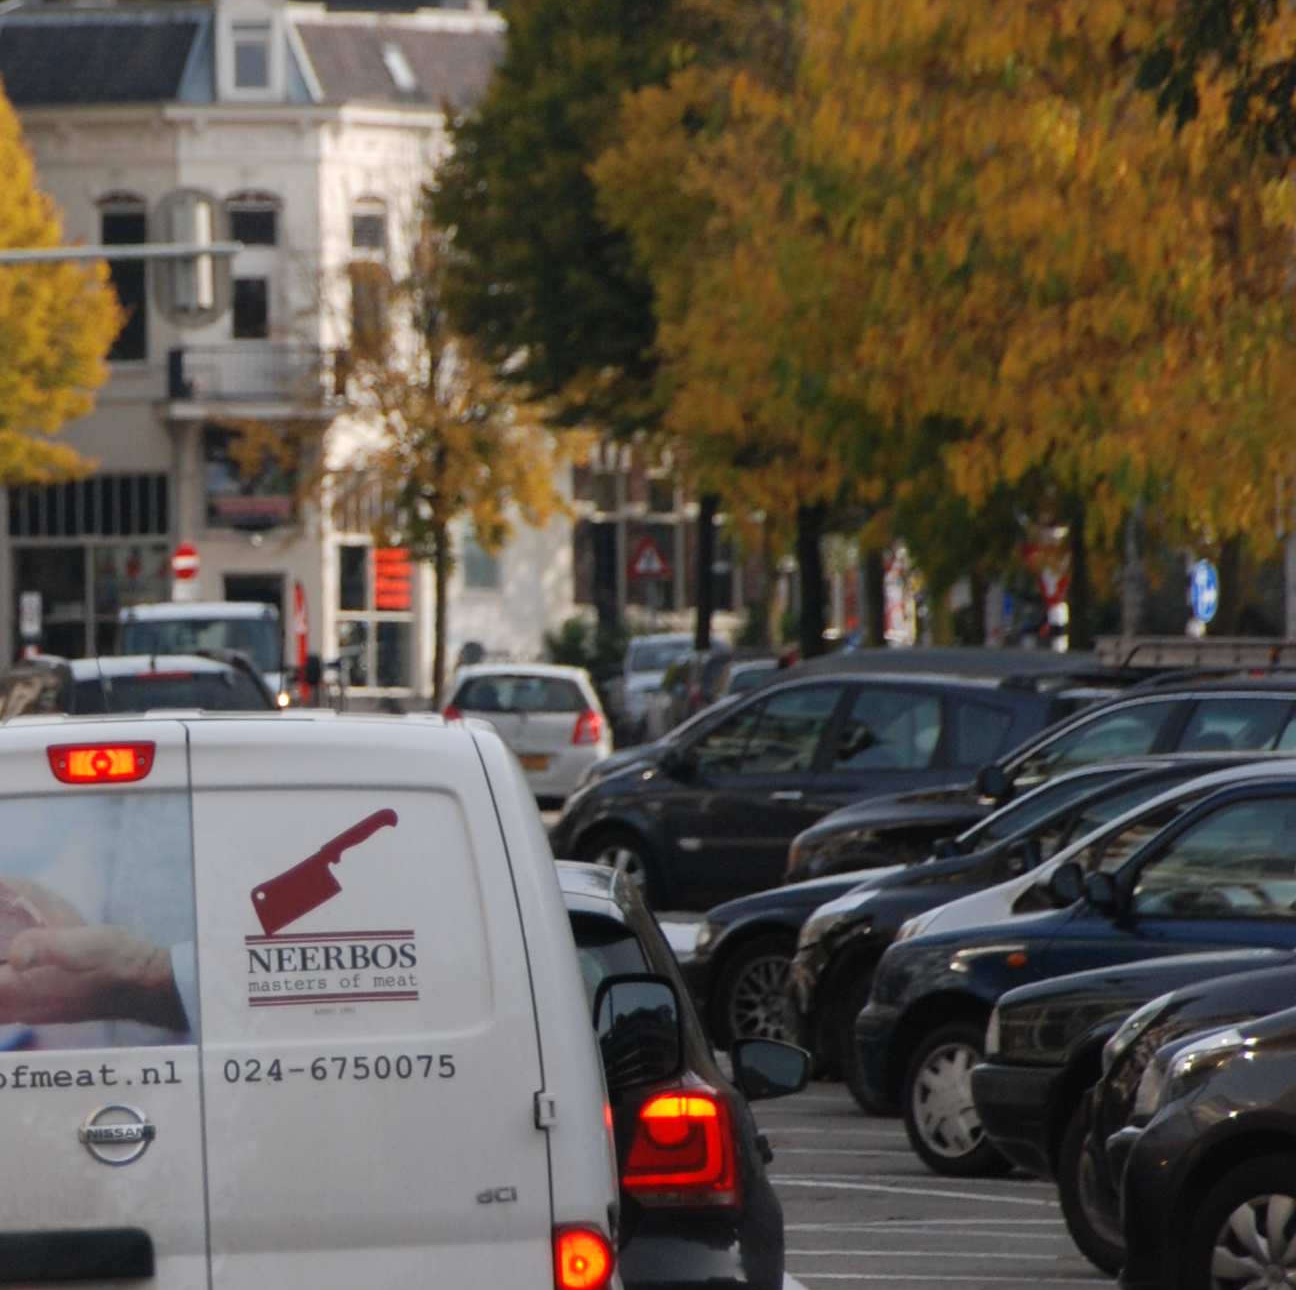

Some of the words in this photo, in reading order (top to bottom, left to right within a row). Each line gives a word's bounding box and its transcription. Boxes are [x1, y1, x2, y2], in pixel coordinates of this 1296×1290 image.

[247, 942, 417, 975] NEERBOS
[248, 978, 327, 993] masters
[339, 974, 361, 989] of
[373, 973, 418, 989] meat
[223, 1054, 457, 1084] 024-6750075
[85, 1126, 147, 1141] NISSAN
